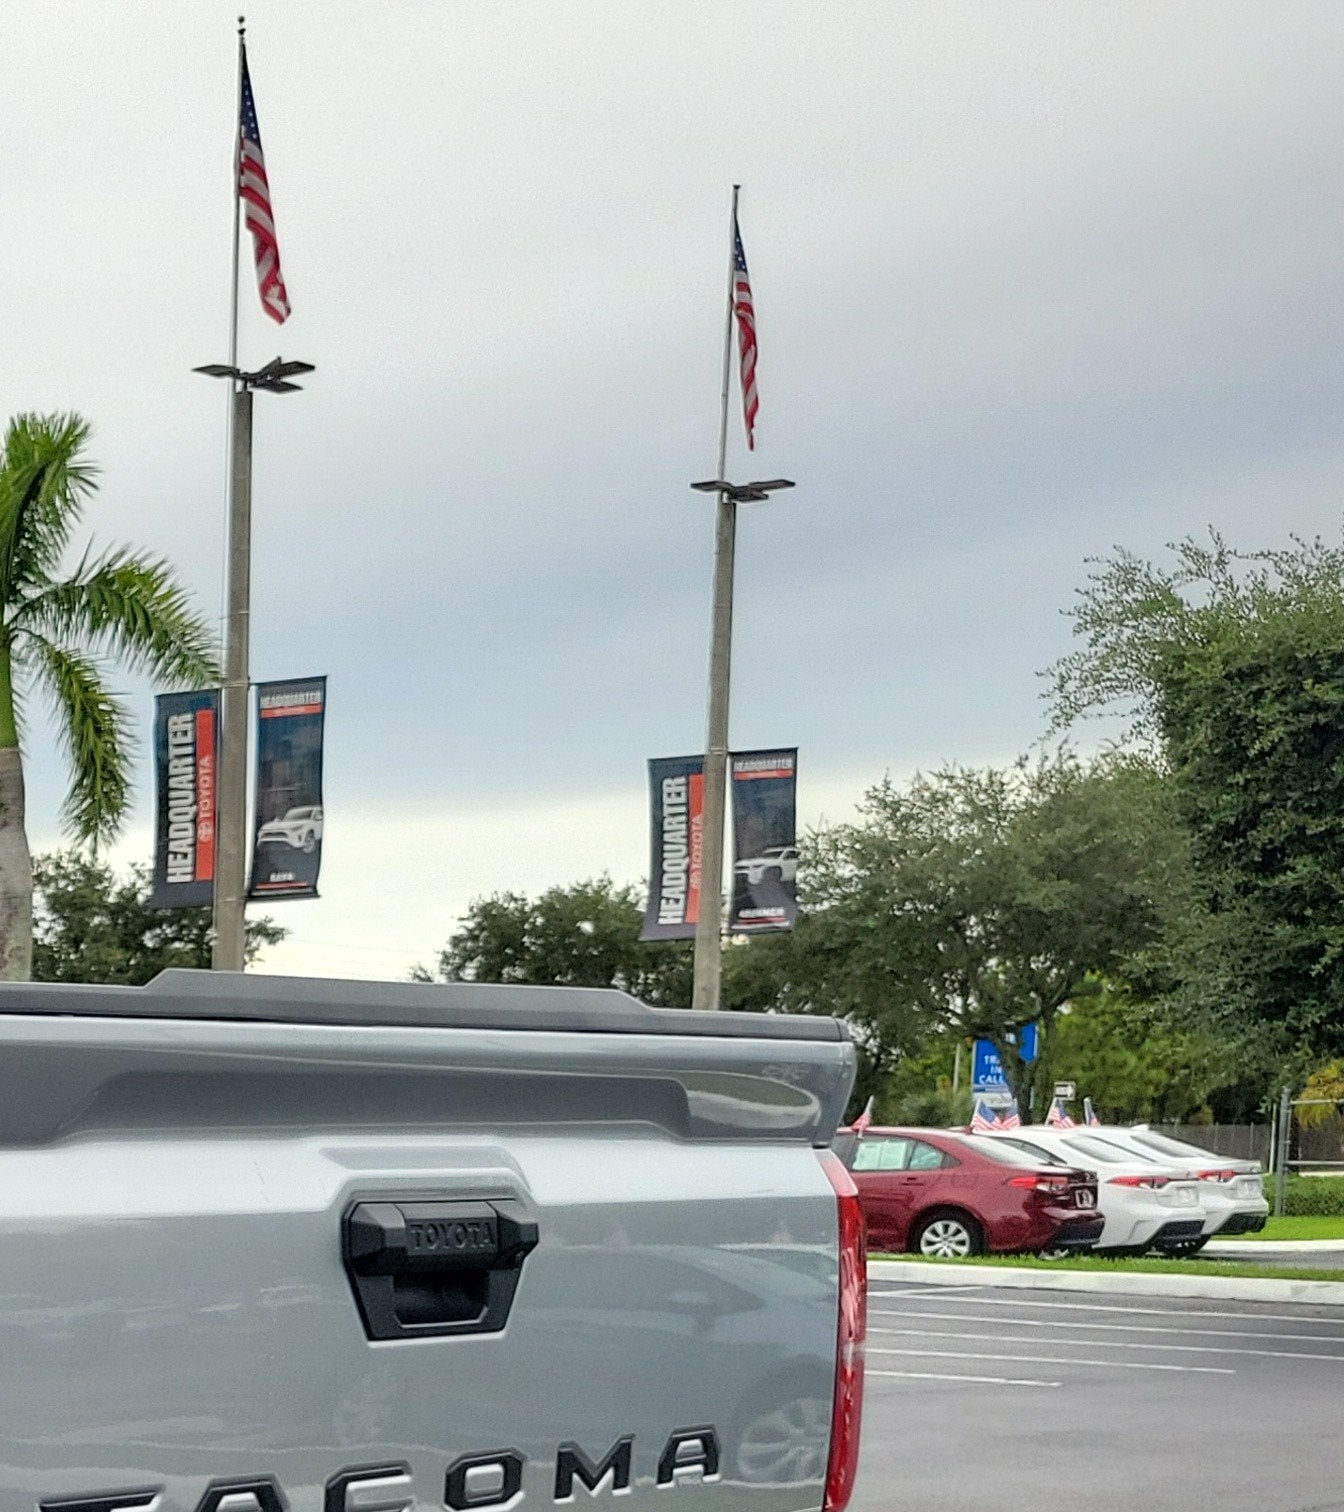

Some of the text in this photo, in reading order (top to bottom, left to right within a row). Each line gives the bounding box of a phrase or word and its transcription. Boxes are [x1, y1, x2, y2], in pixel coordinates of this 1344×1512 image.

[167, 713, 195, 882] HEADQUARTER
[657, 777, 689, 924] HEADQUARTER
[410, 1222, 495, 1250] TOYOTA
